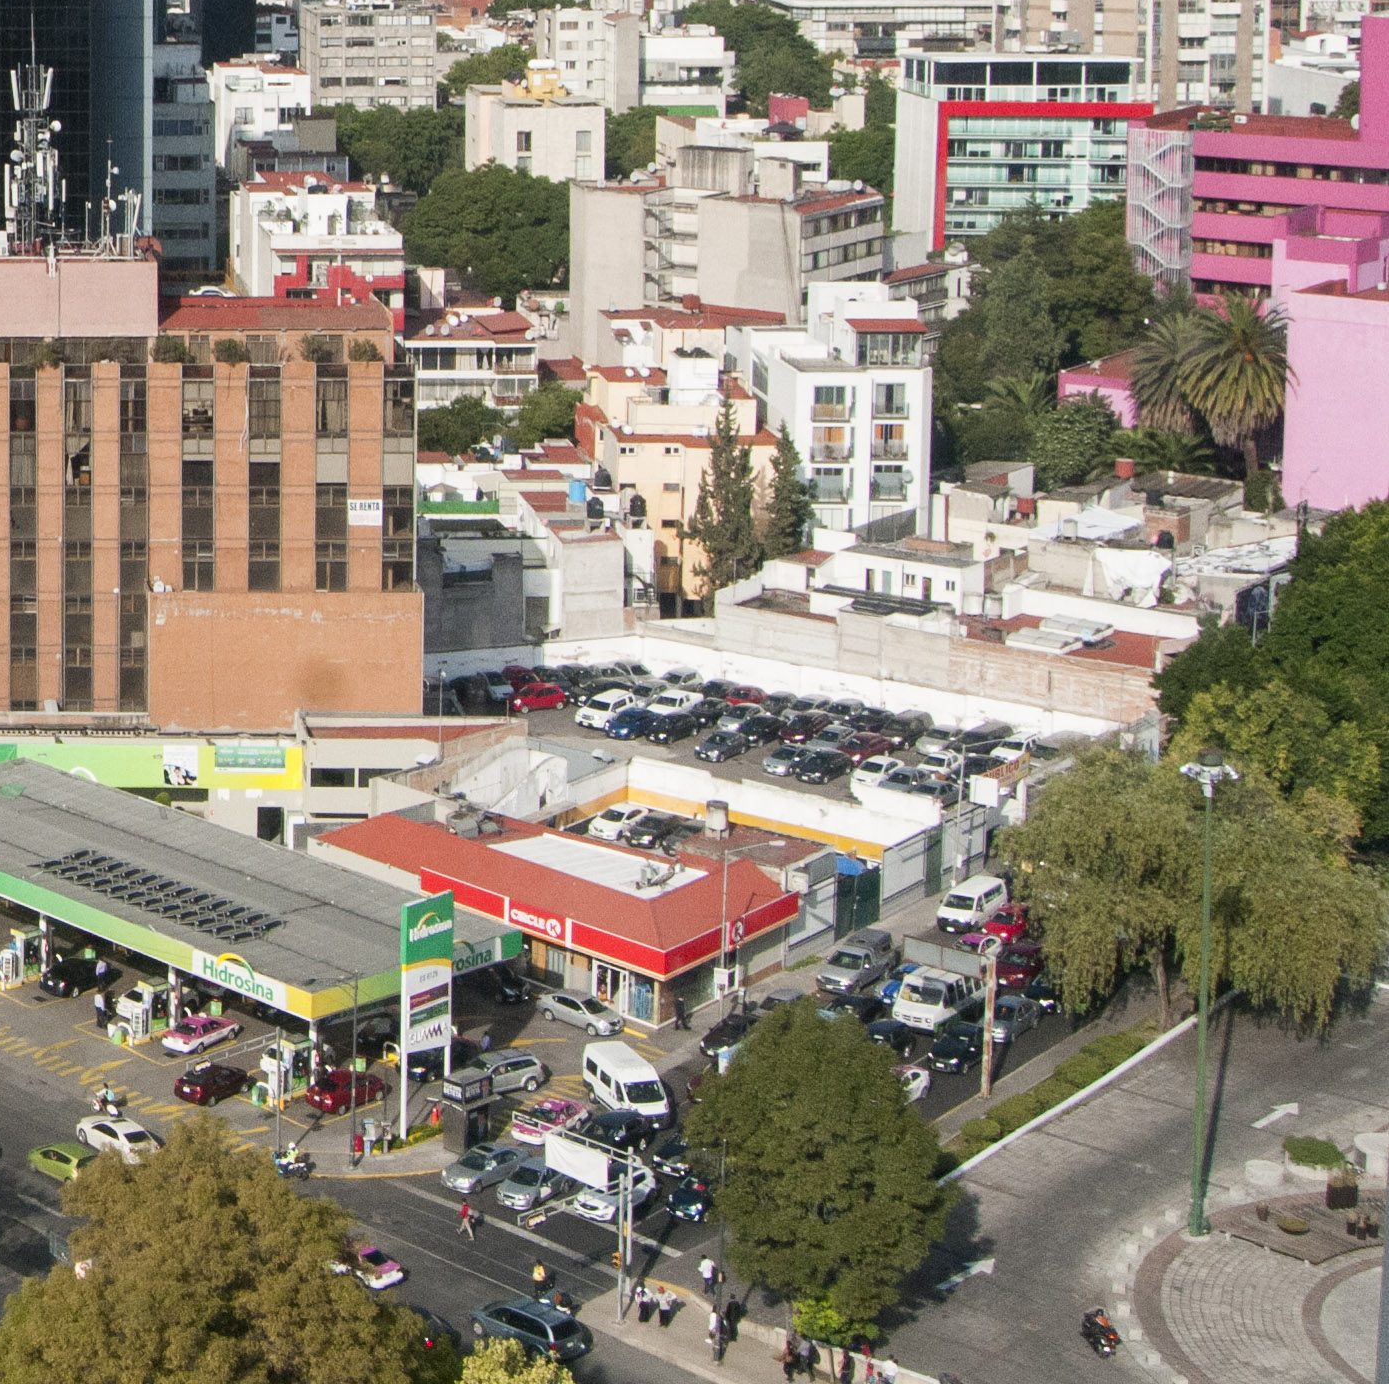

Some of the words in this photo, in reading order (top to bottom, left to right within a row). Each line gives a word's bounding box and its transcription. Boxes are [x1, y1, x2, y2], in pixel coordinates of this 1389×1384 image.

[349, 502, 358, 512] SE
[359, 501, 381, 511] RENTA
[510, 909, 546, 930] CIRCLE
[409, 920, 453, 942] Hidrosina
[203, 957, 274, 1001] Hidrosina
